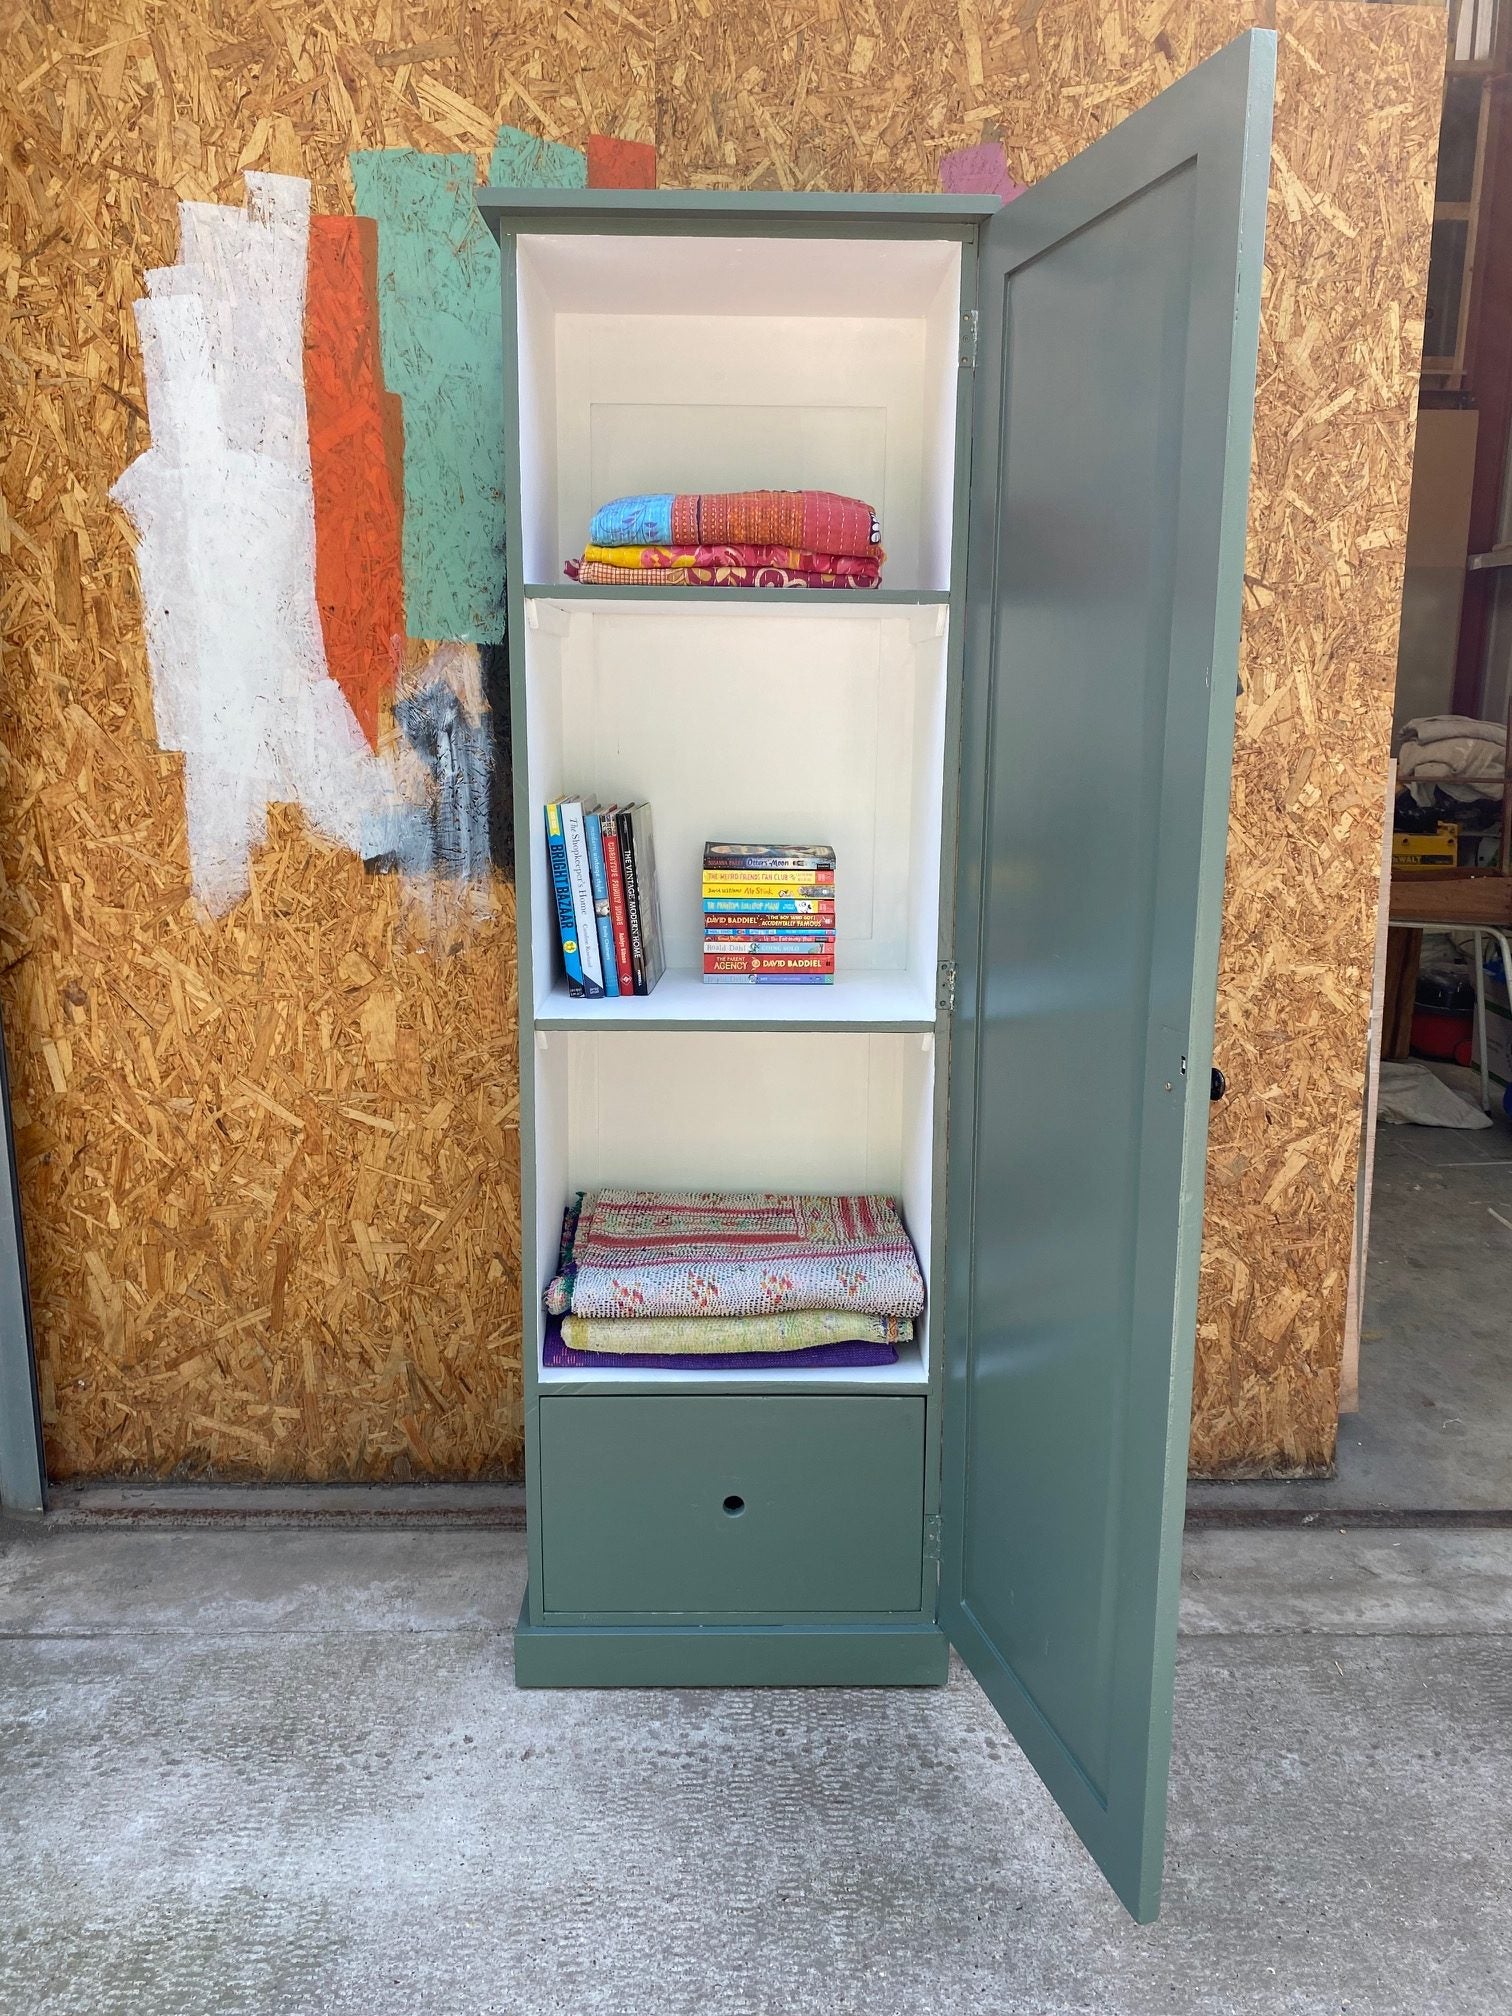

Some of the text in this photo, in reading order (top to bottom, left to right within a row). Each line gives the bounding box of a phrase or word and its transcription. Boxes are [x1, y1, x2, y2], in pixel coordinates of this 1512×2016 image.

[550, 845, 569, 886] BRIGHT
[570, 818, 587, 915] The Shopkeeper's Home
[589, 827, 597, 851] modern
[595, 877, 604, 892] style
[708, 872, 718, 880] THE
[773, 873, 788, 881] CLUB
[608, 842, 624, 926] CREATIVE FAMILY HOME
[625, 864, 636, 900] VINTAGE
[556, 887, 574, 928] BAZAAR
[628, 901, 639, 935] MODERN
[706, 916, 758, 924] DAVID BADDIEL
[632, 936, 641, 959] HOME
[714, 962, 748, 970] AGENCY
